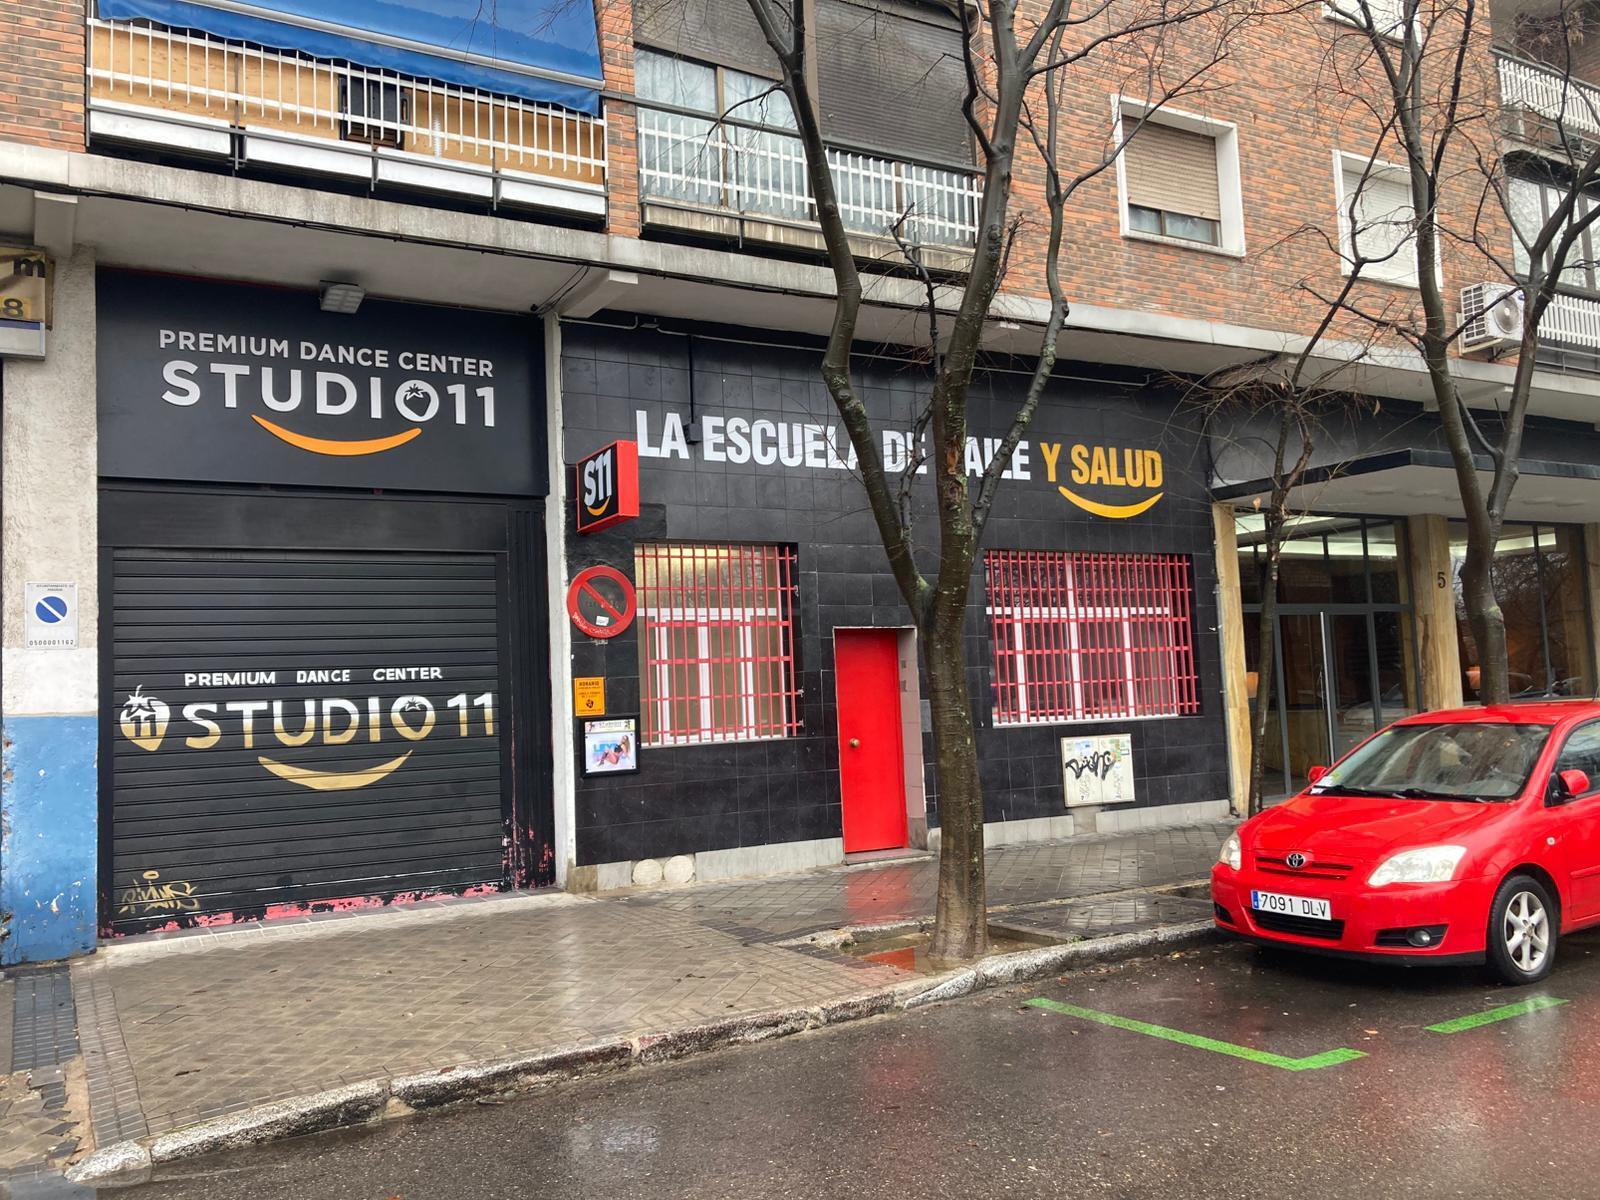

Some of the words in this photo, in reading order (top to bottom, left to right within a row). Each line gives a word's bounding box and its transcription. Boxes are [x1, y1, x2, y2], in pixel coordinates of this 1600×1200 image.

[159, 329, 289, 359] PREMIUM
[300, 341, 389, 369] DANCE
[398, 351, 494, 378] CENTER
[635, 409, 690, 461] LA
[1040, 441, 1061, 482] Y
[1071, 446, 1164, 489] SALUD
[583, 448, 613, 507] S11
[1436, 571, 1447, 589] 5
[184, 670, 277, 688] PREMIUM
[296, 668, 351, 685] DANCE
[372, 666, 443, 682] CENTER
[130, 713, 157, 737] 11
[1260, 893, 1294, 913] 7091
[1301, 899, 1327, 918] DLV
